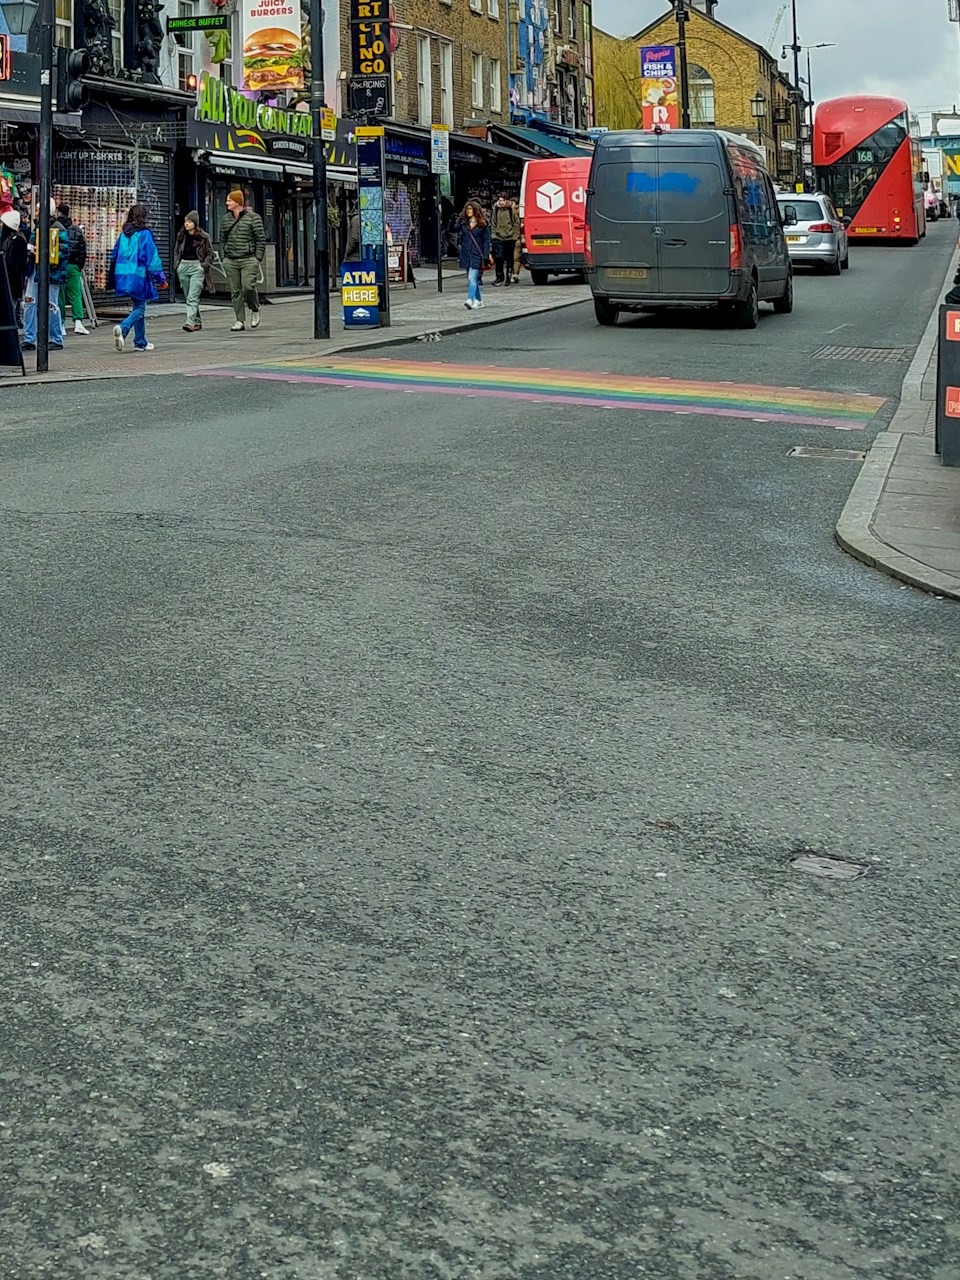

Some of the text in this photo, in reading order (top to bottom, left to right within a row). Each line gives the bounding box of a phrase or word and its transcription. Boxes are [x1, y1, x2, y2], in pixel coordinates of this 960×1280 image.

[257, 0, 286, 8] JUICY
[250, 7, 294, 17] BURGERS
[168, 17, 225, 28] CHINESE BUFFET
[643, 63, 673, 71] FISH &
[195, 70, 226, 124] ALL
[227, 86, 258, 128] YOU
[55, 151, 78, 160] LIGHT
[78, 151, 89, 160] UP
[857, 151, 873, 162] 168
[342, 270, 376, 285] ATM
[343, 289, 376, 303] HERE
